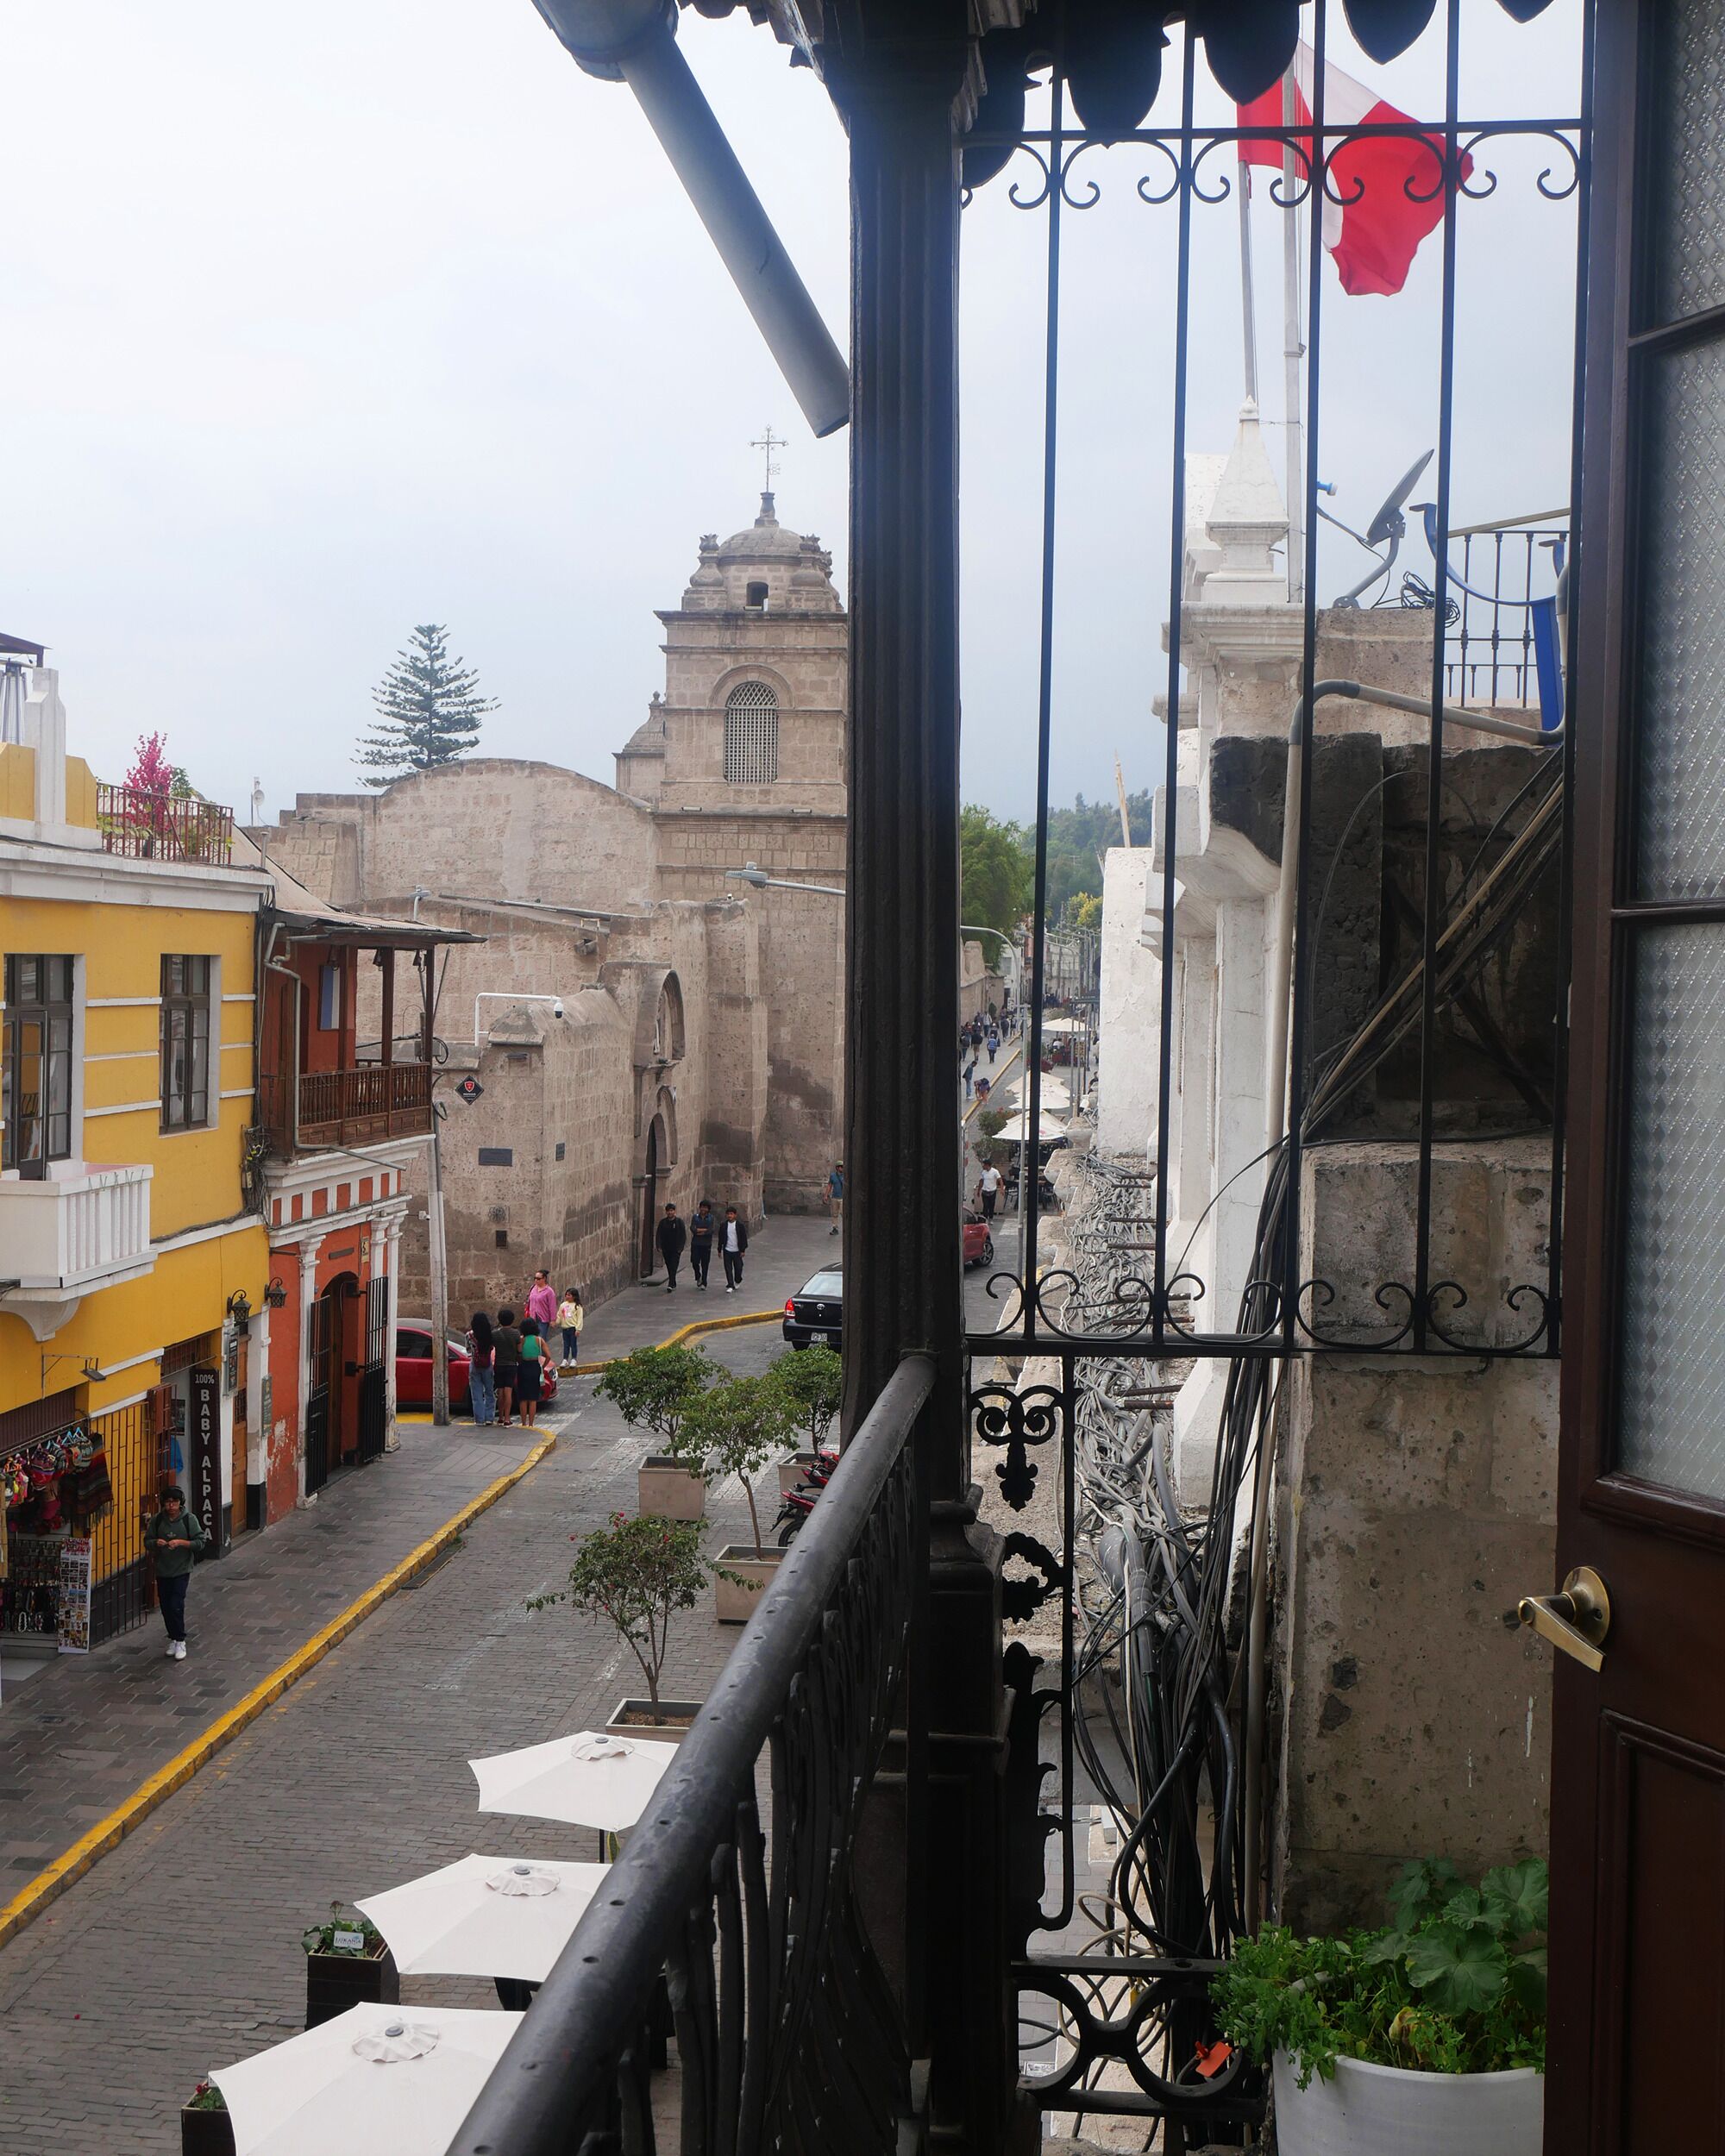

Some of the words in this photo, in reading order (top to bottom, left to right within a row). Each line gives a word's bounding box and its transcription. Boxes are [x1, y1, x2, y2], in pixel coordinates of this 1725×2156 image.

[195, 1374, 215, 1384] 100%
[200, 1388, 211, 1445] BABY
[201, 1455, 213, 1540] ALPACA
